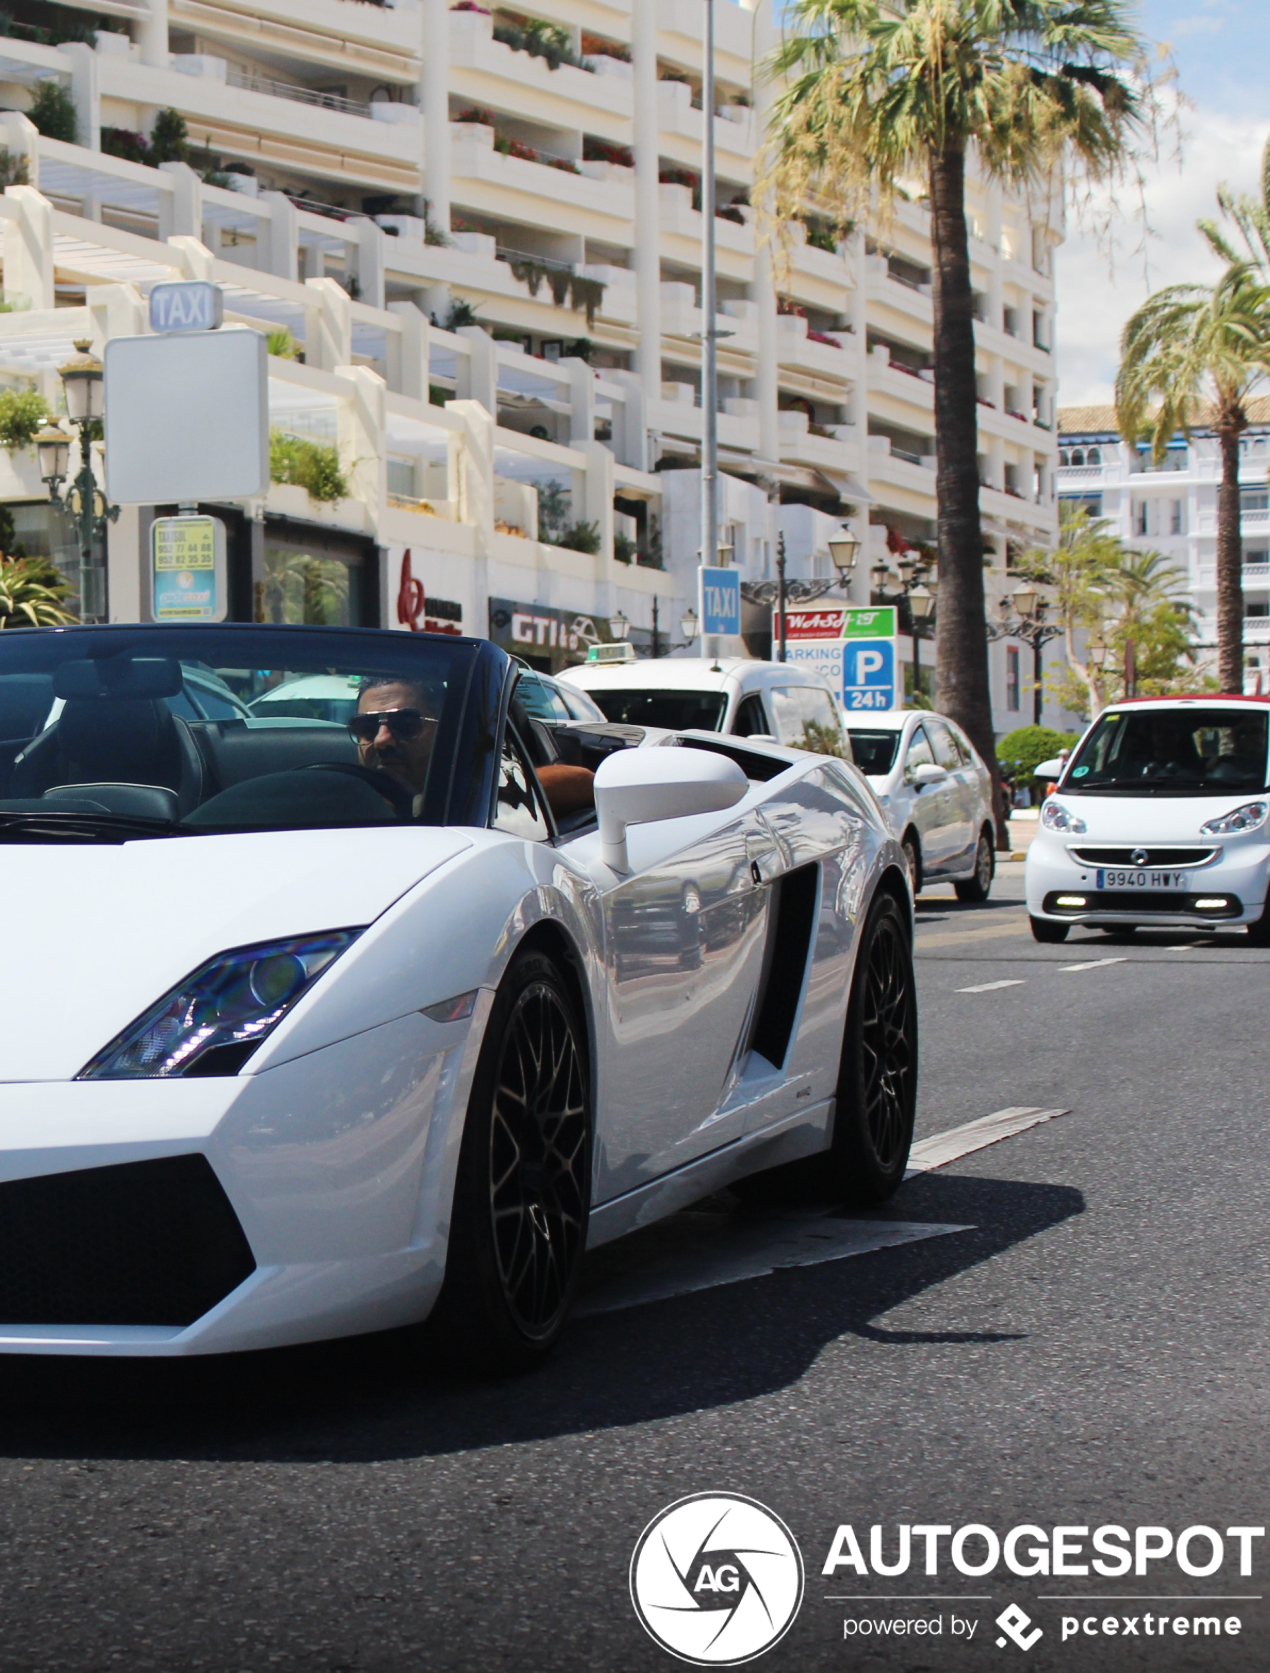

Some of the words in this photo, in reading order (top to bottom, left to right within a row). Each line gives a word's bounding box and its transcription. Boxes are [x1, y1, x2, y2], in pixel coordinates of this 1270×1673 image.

[154, 289, 210, 326] TAXI
[705, 586, 736, 618] TAXI
[786, 613, 854, 629] WASH
[856, 650, 884, 685] P
[851, 691, 886, 708] 24h
[1107, 872, 1146, 886] 9940
[1151, 873, 1181, 887] HWY
